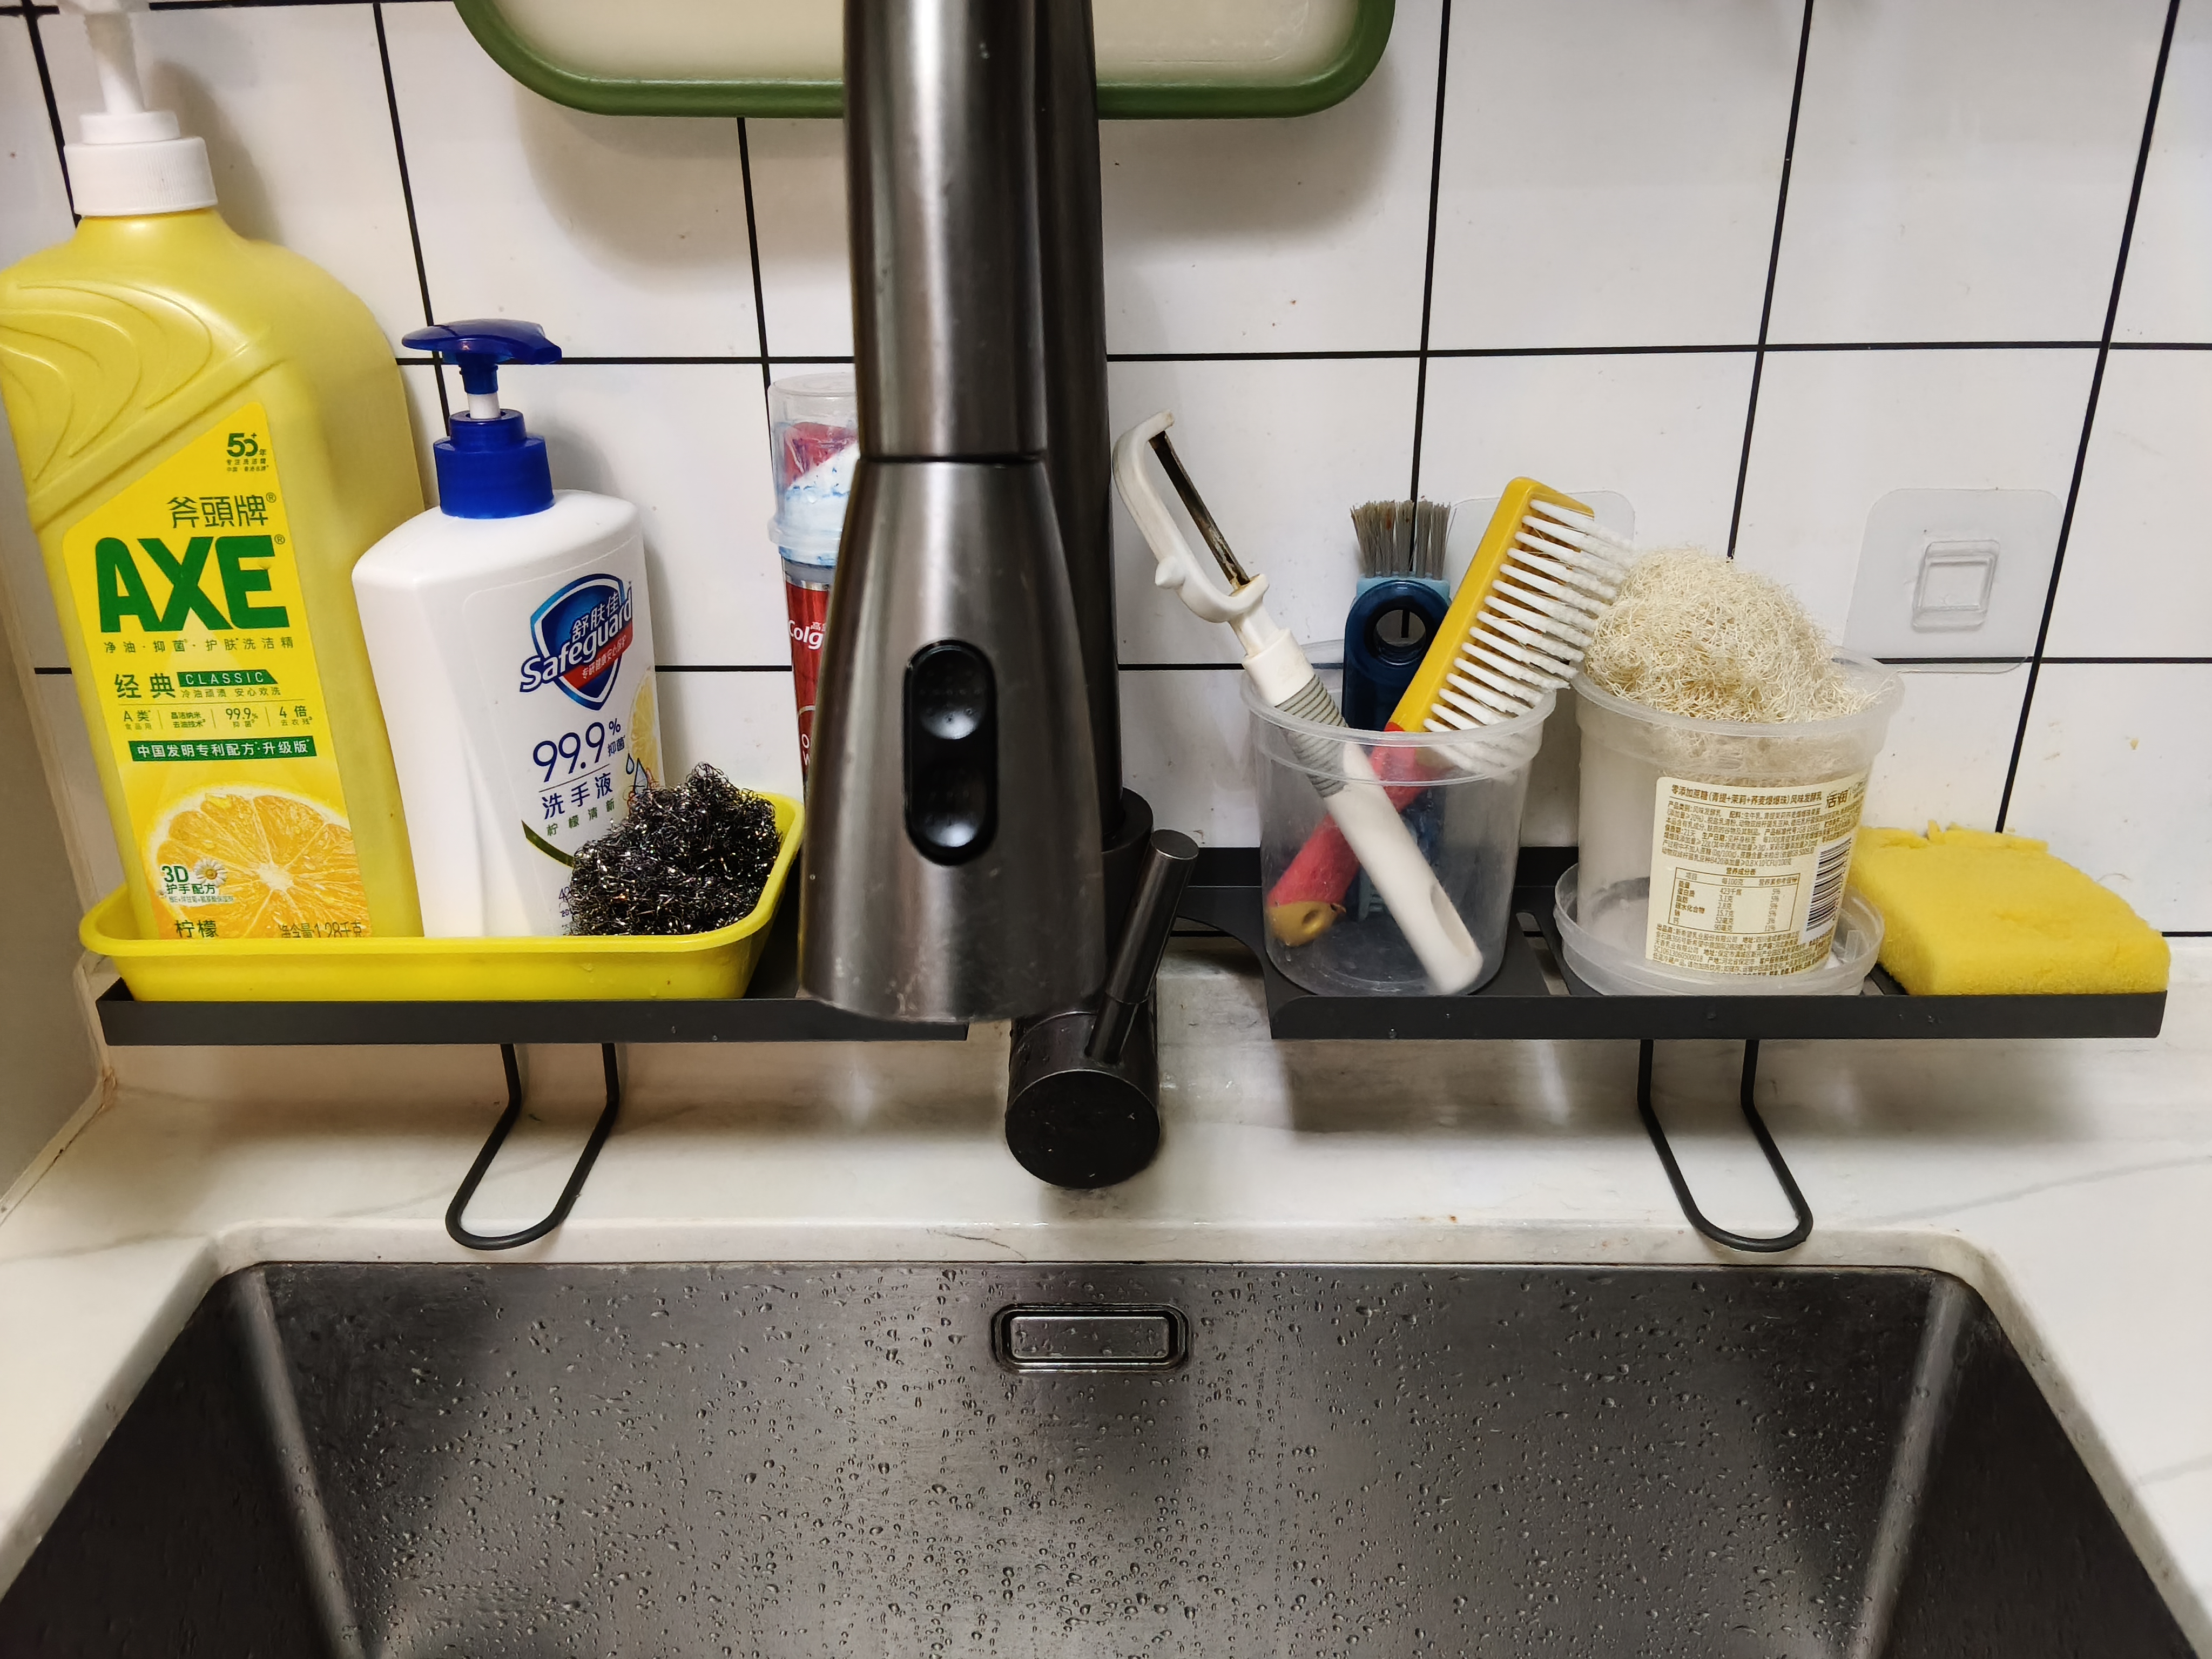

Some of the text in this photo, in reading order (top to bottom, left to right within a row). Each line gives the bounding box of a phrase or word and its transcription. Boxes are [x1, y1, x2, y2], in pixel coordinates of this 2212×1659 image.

[95, 535, 290, 632] AXE
[572, 591, 620, 643] 舒肤佳
[521, 584, 632, 691] Safeguard
[789, 619, 824, 650] Colg
[114, 672, 265, 698] 经典 CLASSIC
[225, 707, 258, 720] 99.9%
[608, 736, 625, 757] 抑菌
[542, 772, 613, 820] 洗手液
[547, 798, 615, 837] 柠檬清新
[162, 866, 188, 882] 3D
[1685, 872, 1697, 880] 项目
[1726, 867, 1756, 875] 营养成分表
[166, 884, 215, 894] 护手配方
[1677, 887, 1695, 898] 蛋白质
[1678, 880, 1690, 889] 能量
[1676, 895, 1688, 903] 脂肪
[1675, 902, 1705, 914] 碳水化合物
[174, 919, 219, 938] 柠檬
